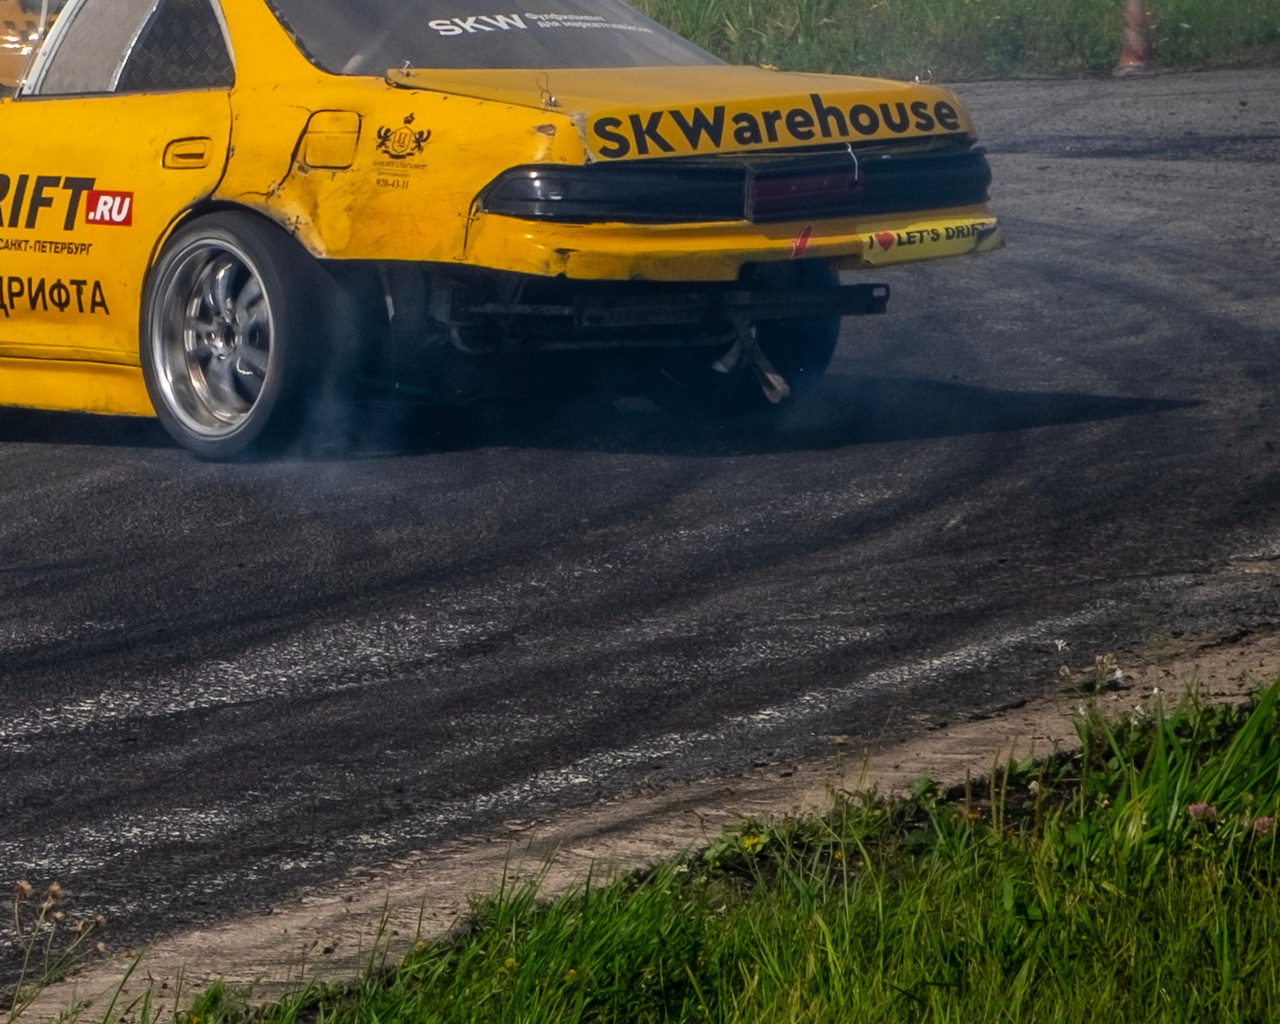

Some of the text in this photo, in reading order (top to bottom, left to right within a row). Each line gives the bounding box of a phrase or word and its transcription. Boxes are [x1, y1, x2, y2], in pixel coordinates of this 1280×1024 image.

[428, 13, 528, 36] SKW
[593, 93, 961, 159] SKWarehouse
[896, 228, 941, 247] LET'S
